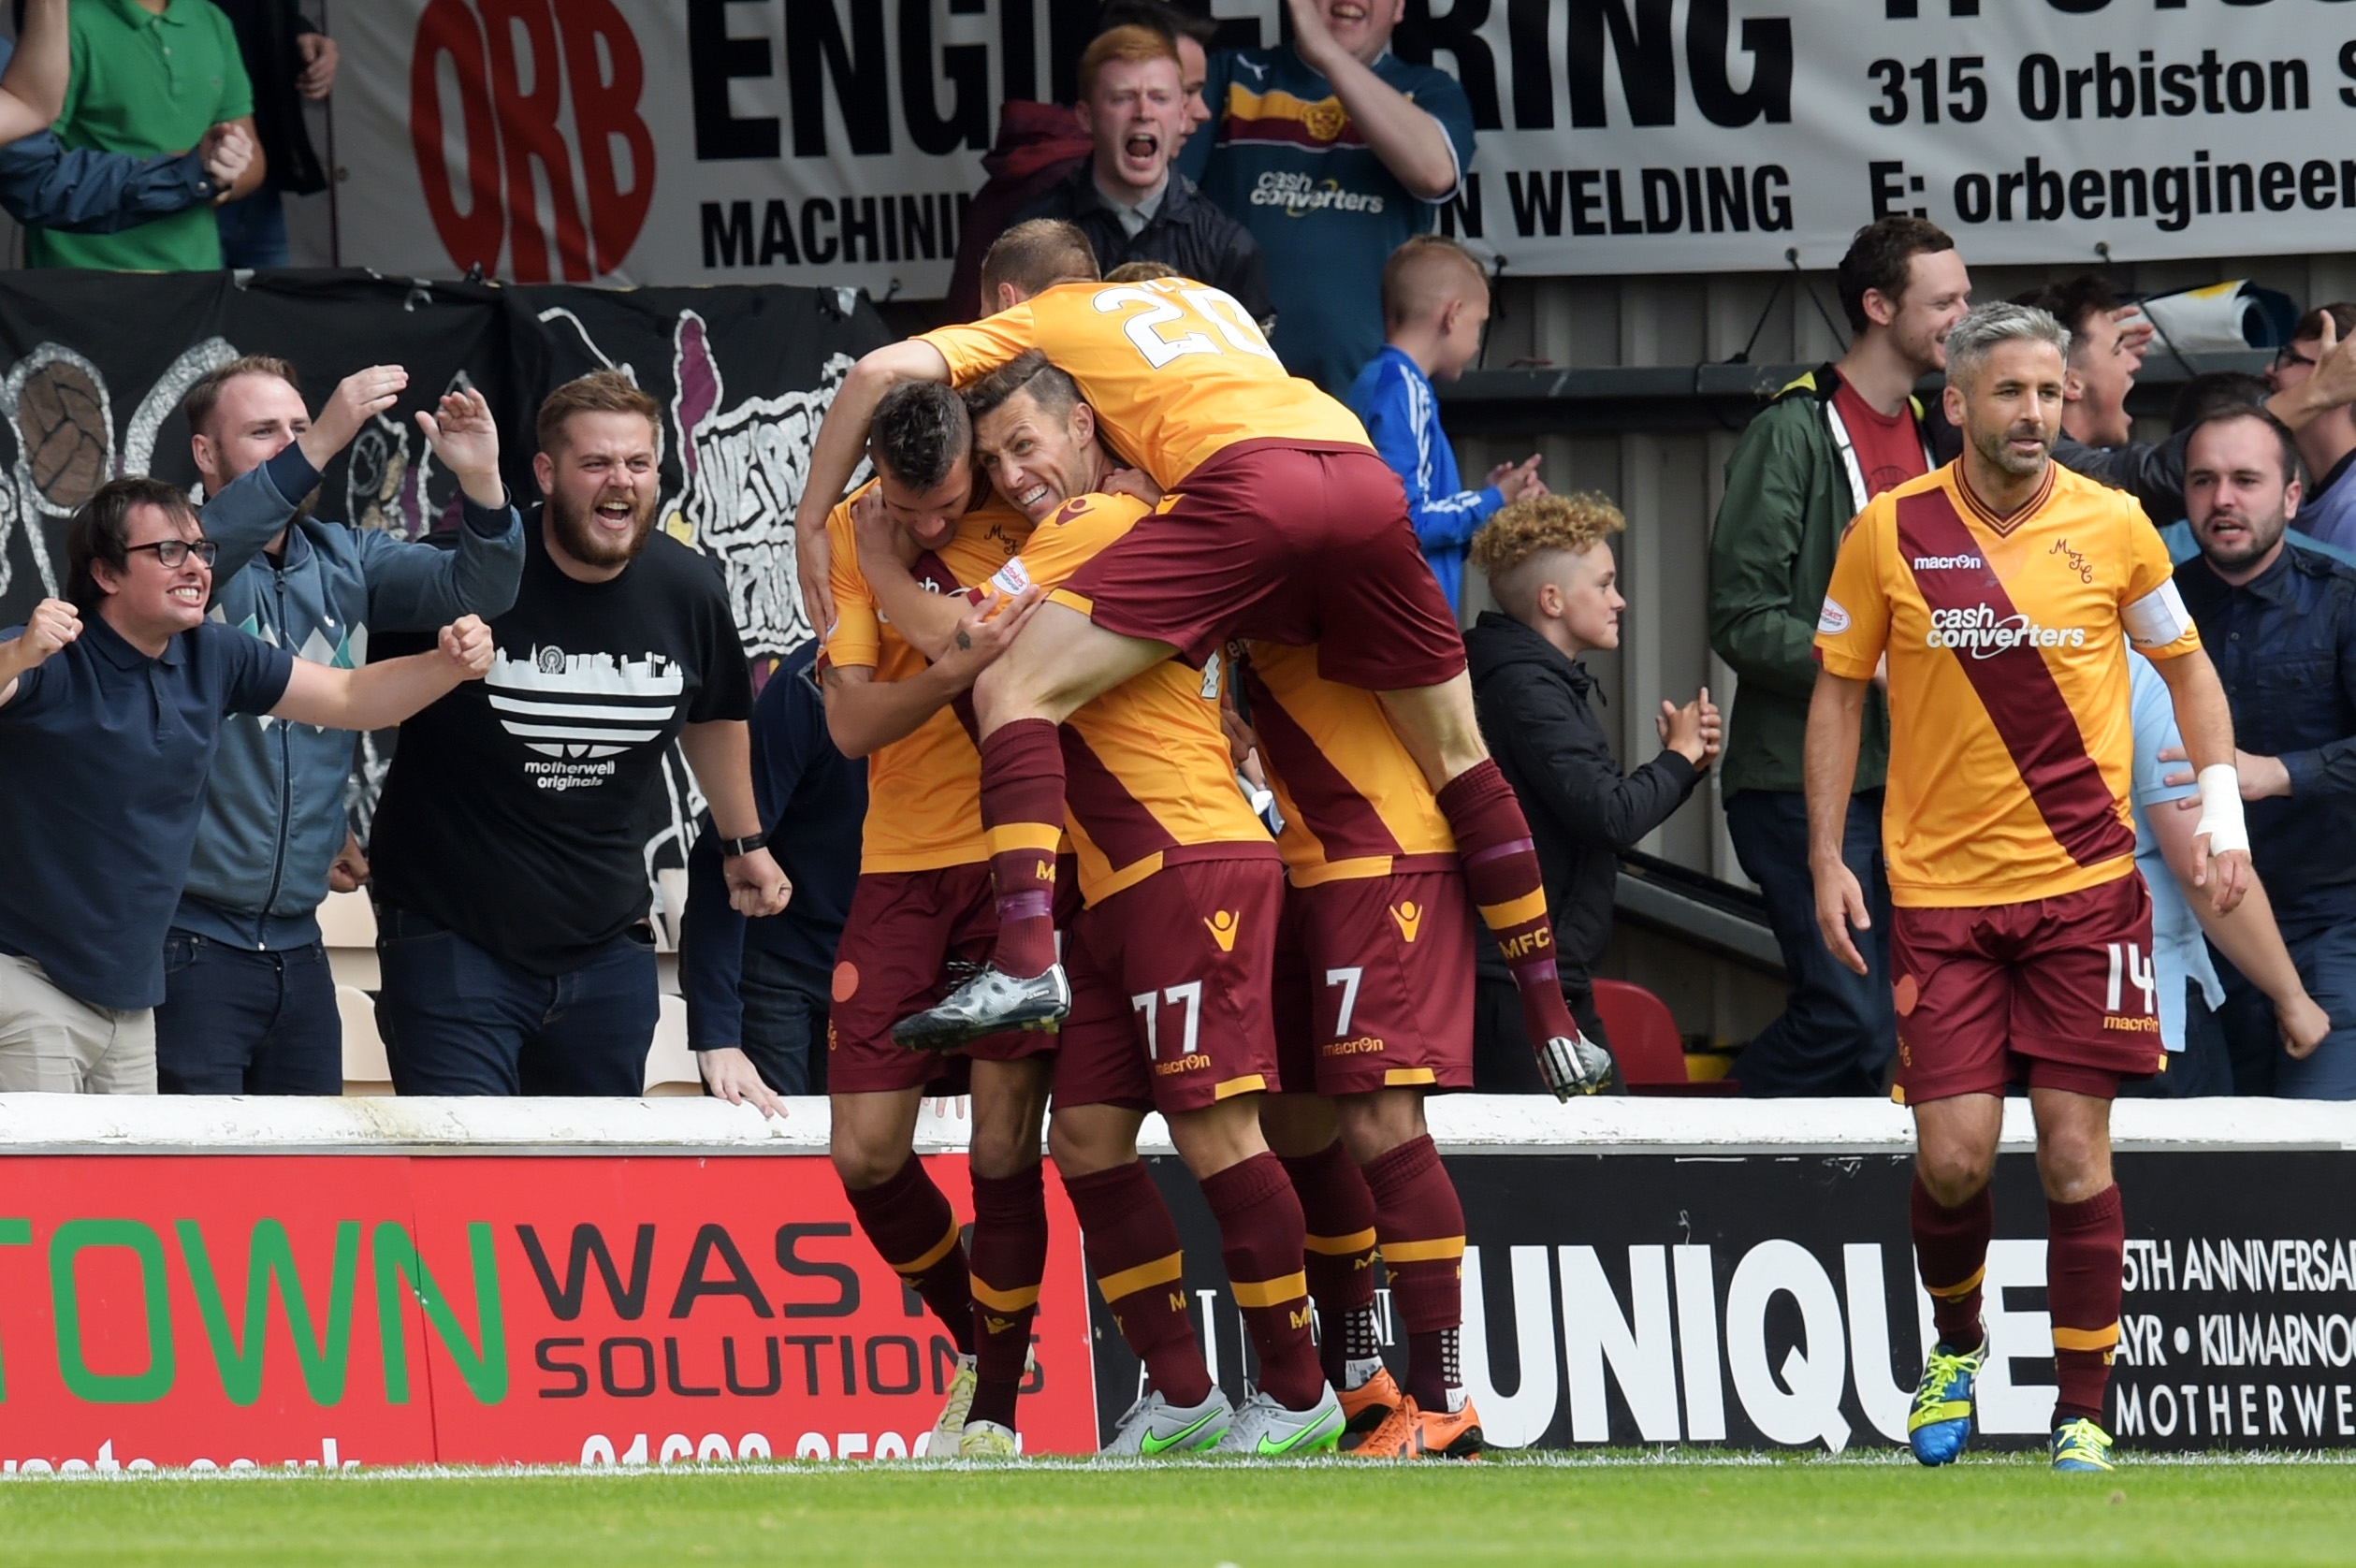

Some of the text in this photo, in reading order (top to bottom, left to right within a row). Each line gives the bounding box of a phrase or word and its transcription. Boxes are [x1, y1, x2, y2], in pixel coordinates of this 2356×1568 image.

[1868, 56, 1987, 125] 315
[2018, 50, 2309, 122] Orbiston
[412, 0, 656, 283] ORB
[1250, 188, 1385, 214] converters
[1258, 171, 1313, 192] cash
[1506, 164, 1793, 238] WELDING
[702, 194, 973, 268] MACHINI
[1092, 286, 1290, 378] 20
[1913, 554, 1982, 571] macron
[1925, 624, 2086, 649] converters
[1929, 602, 1995, 630] cash
[524, 760, 616, 776] motherwell
[537, 775, 604, 791] originals
[1499, 926, 1550, 959] MFC
[1326, 966, 1363, 1037] 7
[2106, 943, 2155, 1014] 14
[1131, 980, 1202, 1060] 77
[1323, 1037, 1384, 1056] macron
[1155, 1053, 1211, 1076] macron
[515, 1222, 1044, 1321] WAS
[1462, 1239, 2058, 1453] UNIQUE
[2112, 1312, 2356, 1368] AYR KILMARNO
[2115, 1382, 2356, 1438] MOTHERWE
